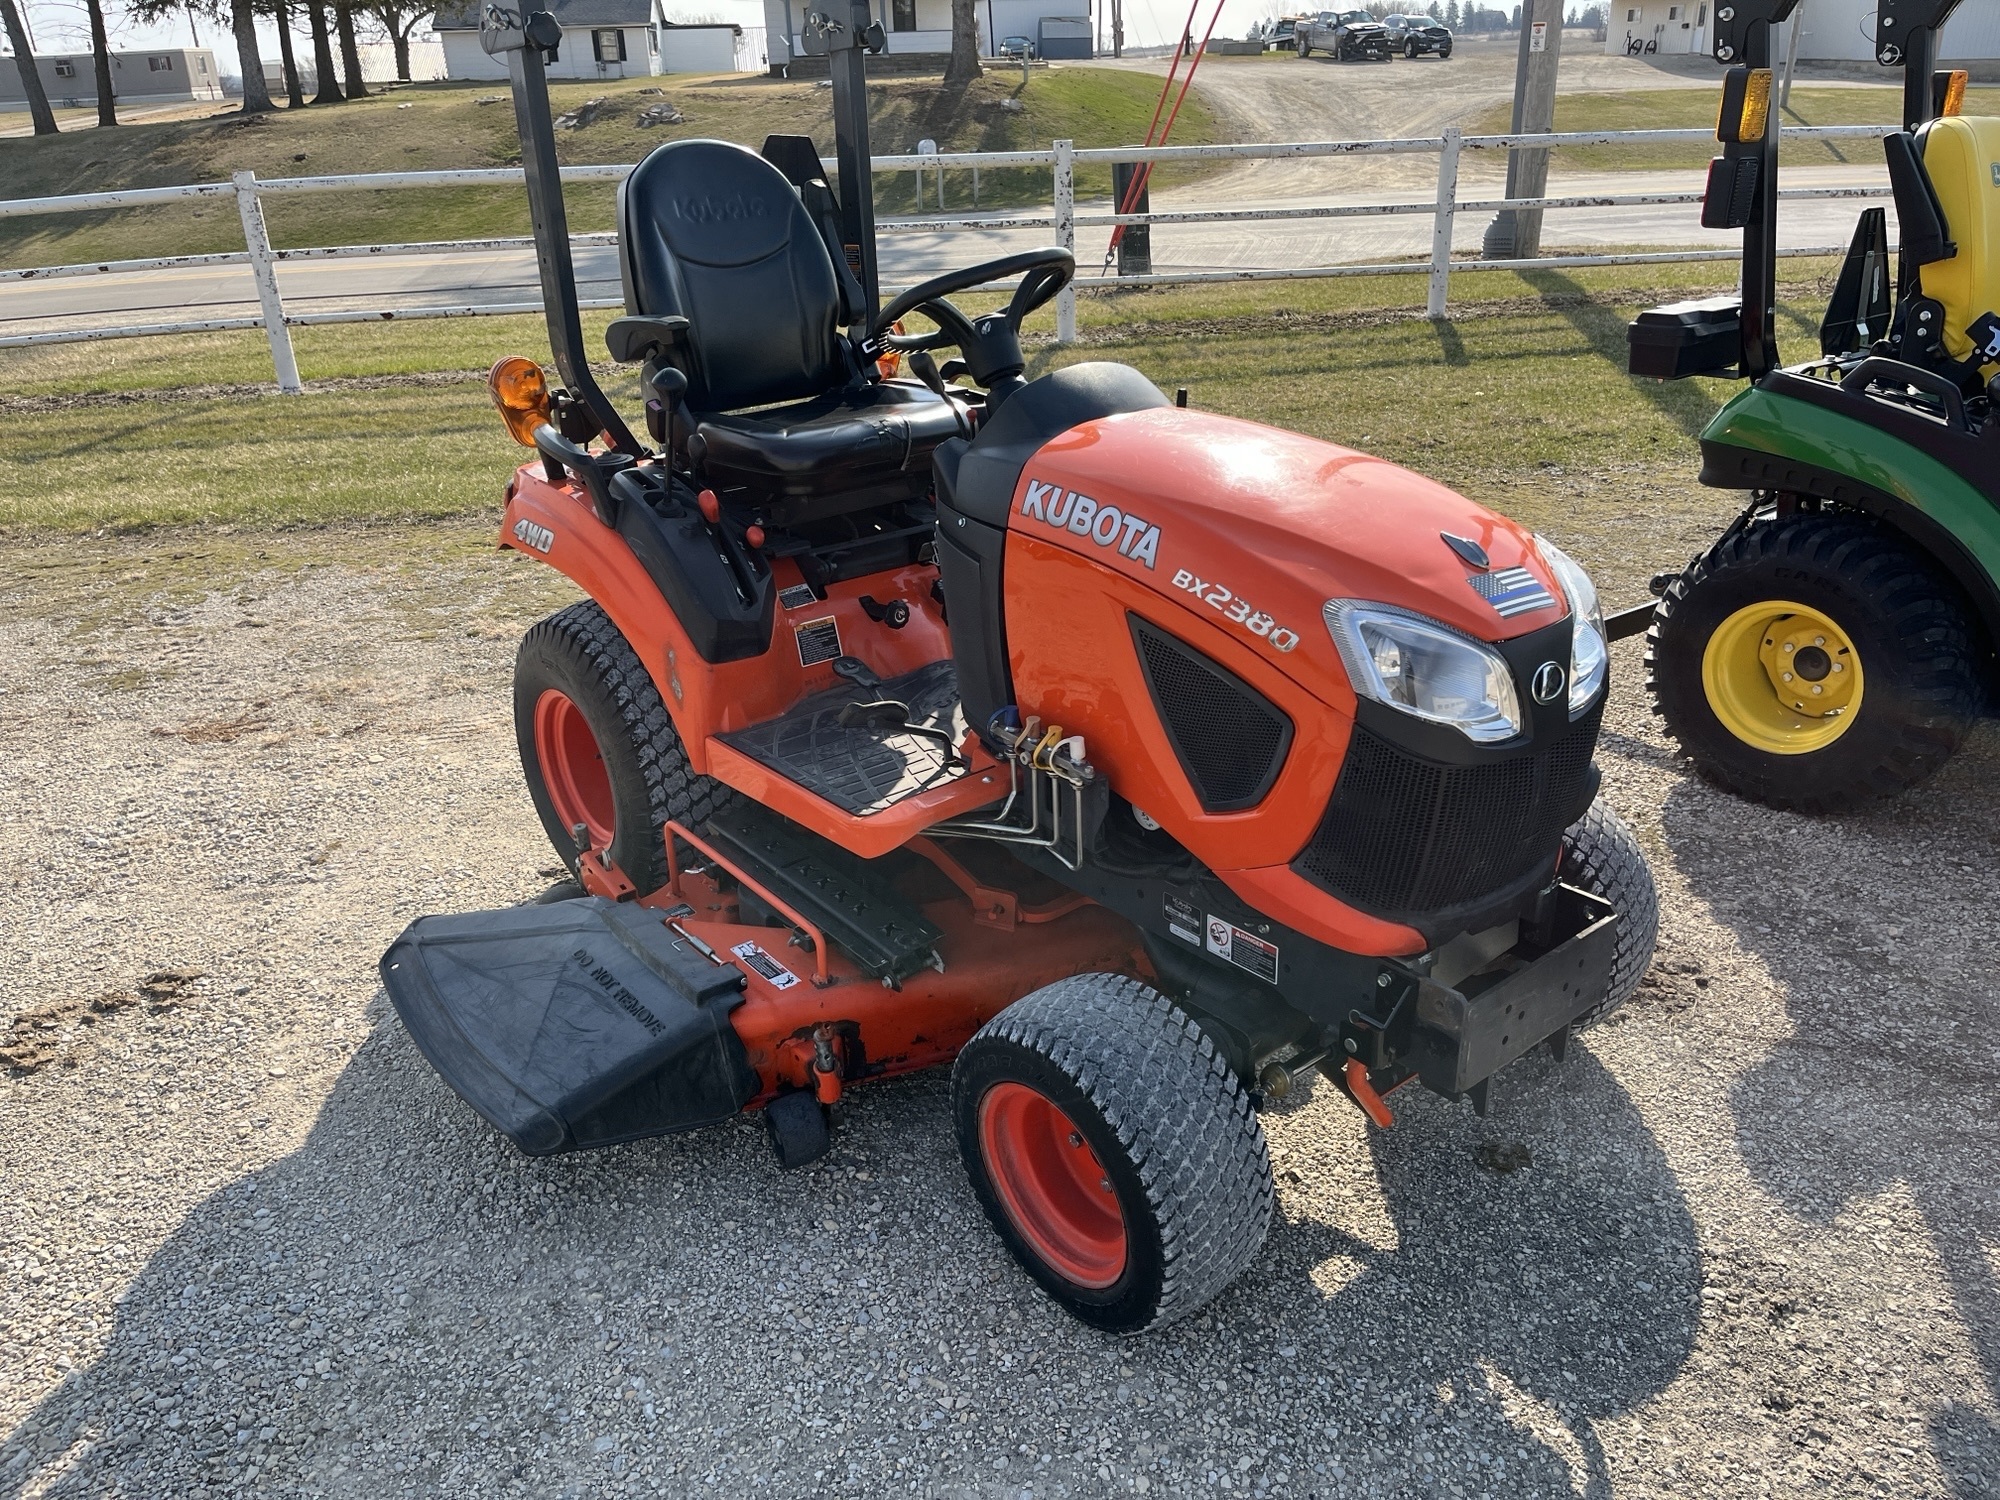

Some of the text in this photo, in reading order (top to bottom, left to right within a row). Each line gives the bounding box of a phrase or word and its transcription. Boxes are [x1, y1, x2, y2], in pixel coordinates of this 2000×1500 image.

[512, 518, 555, 554] 4WD
[1021, 478, 1162, 570] KUBOTA
[1171, 568, 1300, 653] BX2380
[1240, 933, 1264, 949] DANGER
[572, 948, 667, 1038] DO NOT REMOVE
